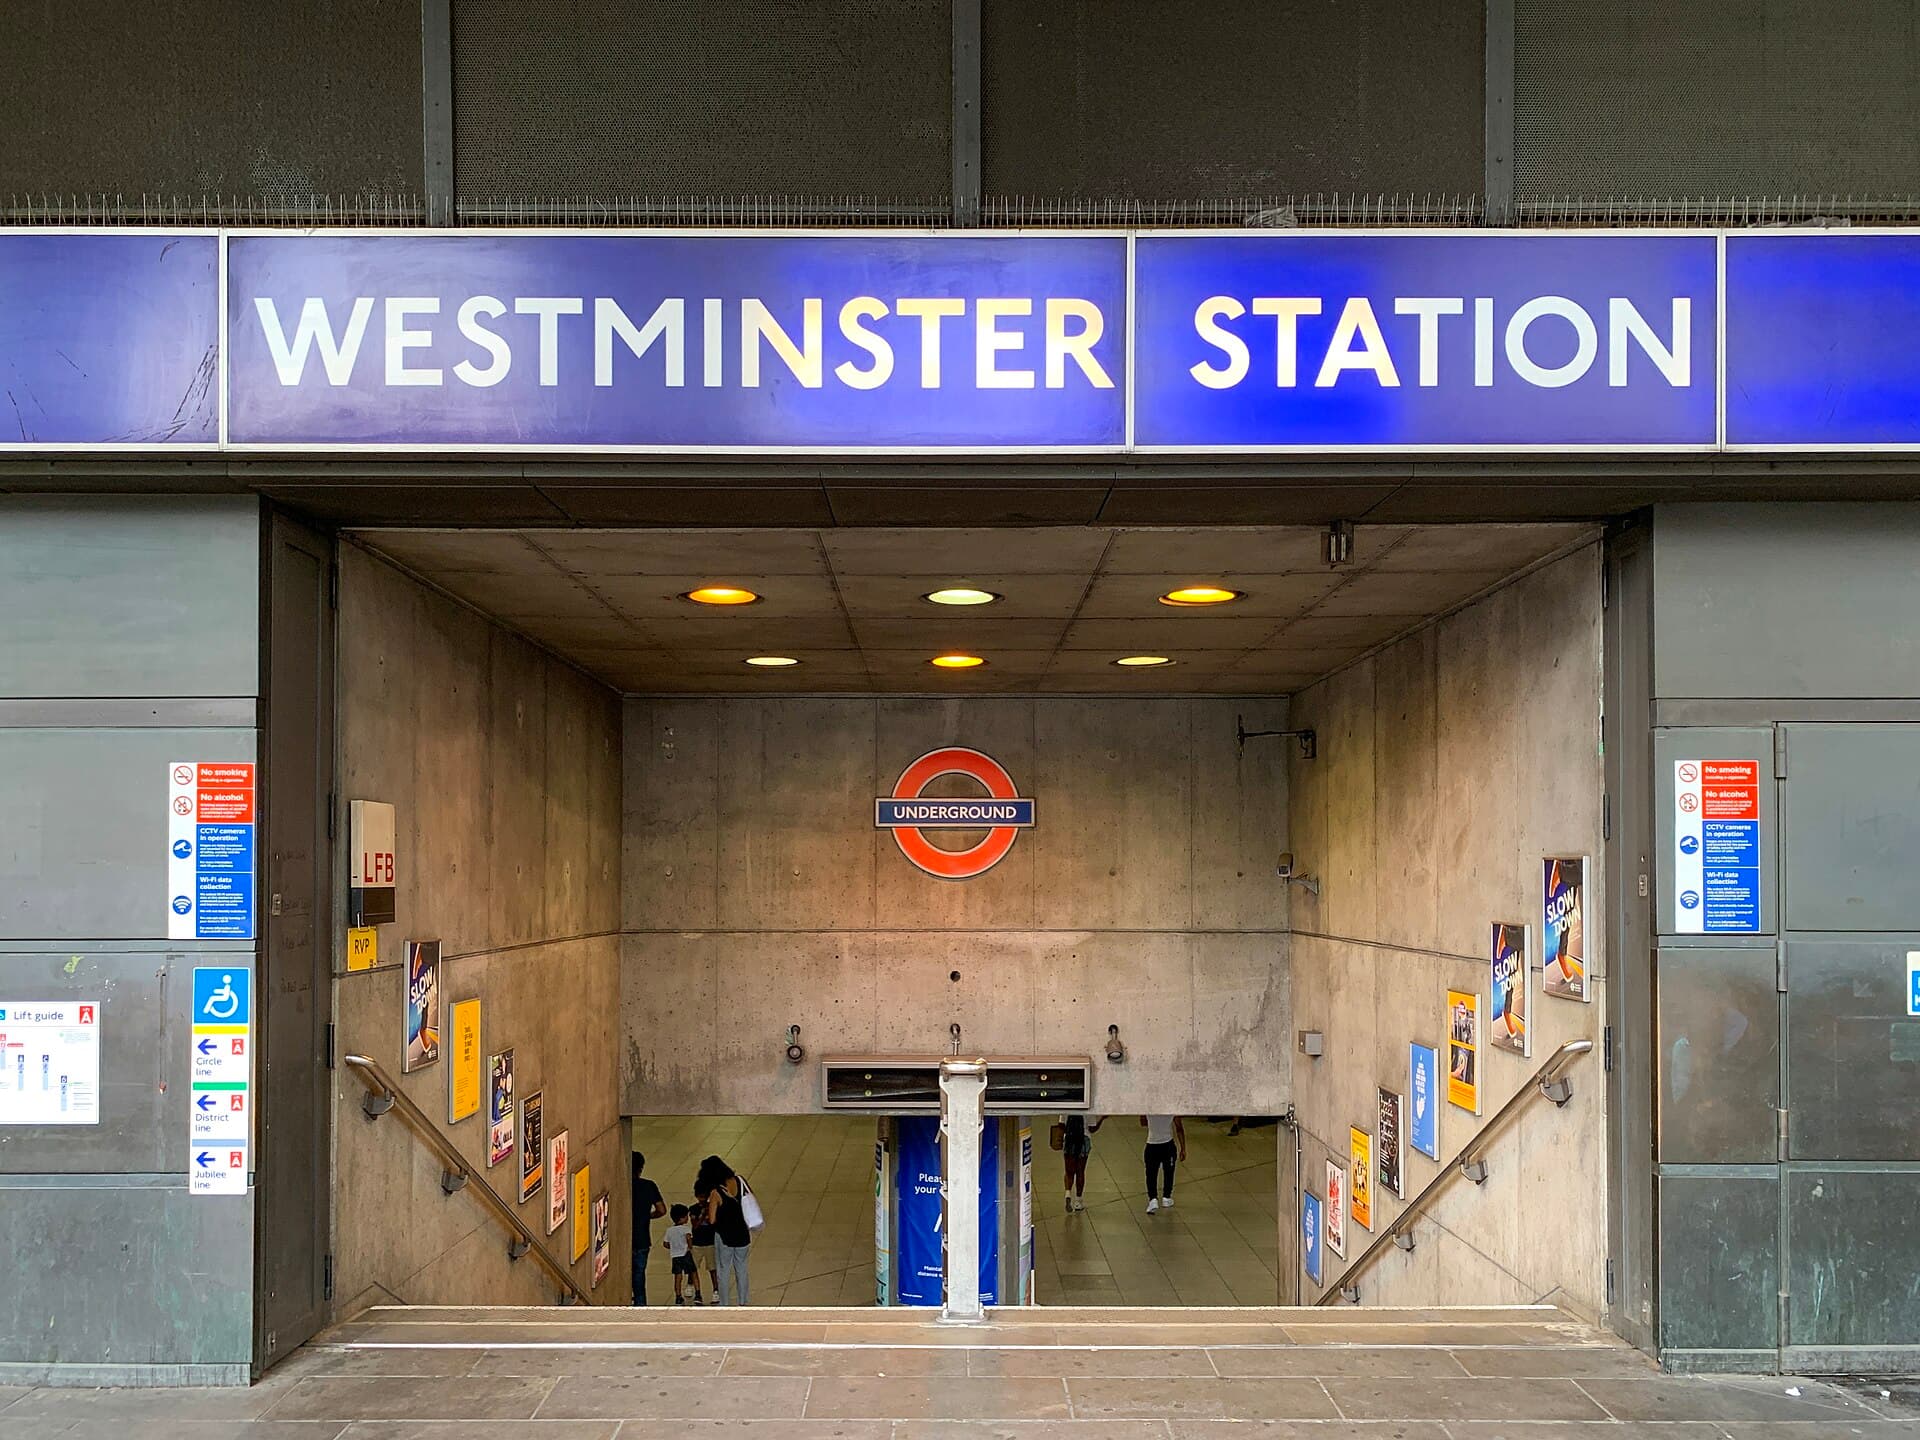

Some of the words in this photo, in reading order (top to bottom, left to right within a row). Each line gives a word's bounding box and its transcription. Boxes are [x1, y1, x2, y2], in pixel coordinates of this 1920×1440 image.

[254, 296, 1114, 389] WESTMINSTER
[1190, 296, 1690, 389] STATION
[200, 768, 213, 776] No
[214, 768, 248, 778] smoking
[1718, 766, 1752, 775] smoking
[1706, 790, 1718, 798] No
[1719, 790, 1748, 798] alcohol
[893, 806, 1017, 819] UNDERGROUND
[1713, 830, 1744, 838] operation
[364, 852, 394, 883] LFB
[1547, 886, 1575, 923] SLOW
[1552, 908, 1581, 937] DOWN
[354, 938, 370, 954] RVP
[1494, 950, 1518, 982] SLOW
[411, 965, 433, 1004] SLOW
[1500, 969, 1523, 994] DOWN
[416, 983, 438, 1014] DOWN
[14, 1011, 32, 1020] Lift
[35, 1011, 64, 1022] guide
[80, 1012, 92, 1024] A
[233, 1043, 242, 1053] A
[196, 1057, 222, 1066] Circle
[196, 1068, 212, 1076] line
[232, 1100, 242, 1110] A
[196, 1114, 229, 1122] District
[195, 1124, 211, 1132] line
[232, 1156, 242, 1168] A
[195, 1170, 226, 1178] Jubilee
[194, 1181, 210, 1189] line
[914, 1185, 937, 1195] your
